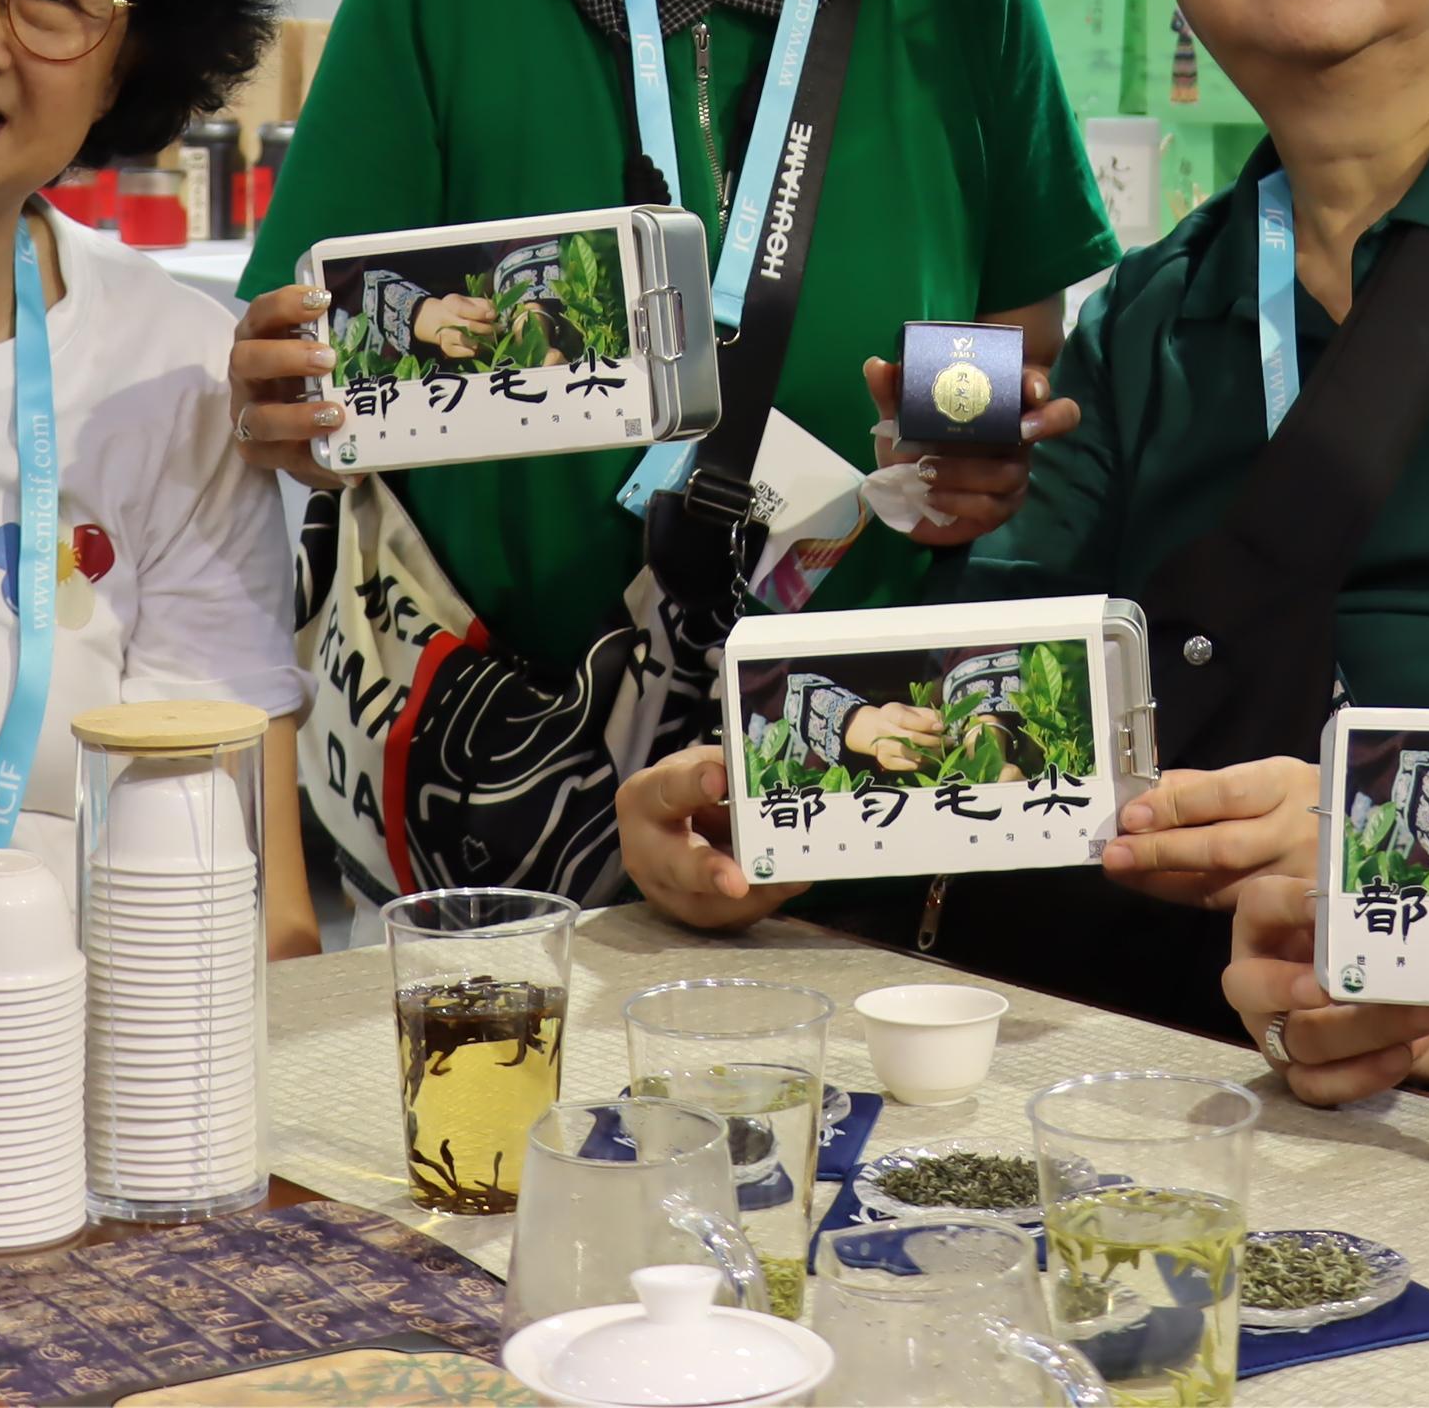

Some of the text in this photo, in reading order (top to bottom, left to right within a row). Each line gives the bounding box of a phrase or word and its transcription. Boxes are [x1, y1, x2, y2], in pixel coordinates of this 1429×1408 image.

[634, 33, 660, 89] ICIF
[732, 196, 762, 254] ICIF
[1264, 208, 1286, 251] ICIF
[344, 346, 628, 422] 都匀毛尖
[519, 408, 624, 427] 都匀毛尖
[31, 412, 54, 631] www.cnicif.com
[759, 763, 1092, 835] 都匀毛尖
[968, 826, 1090, 846] 都匀毛尖
